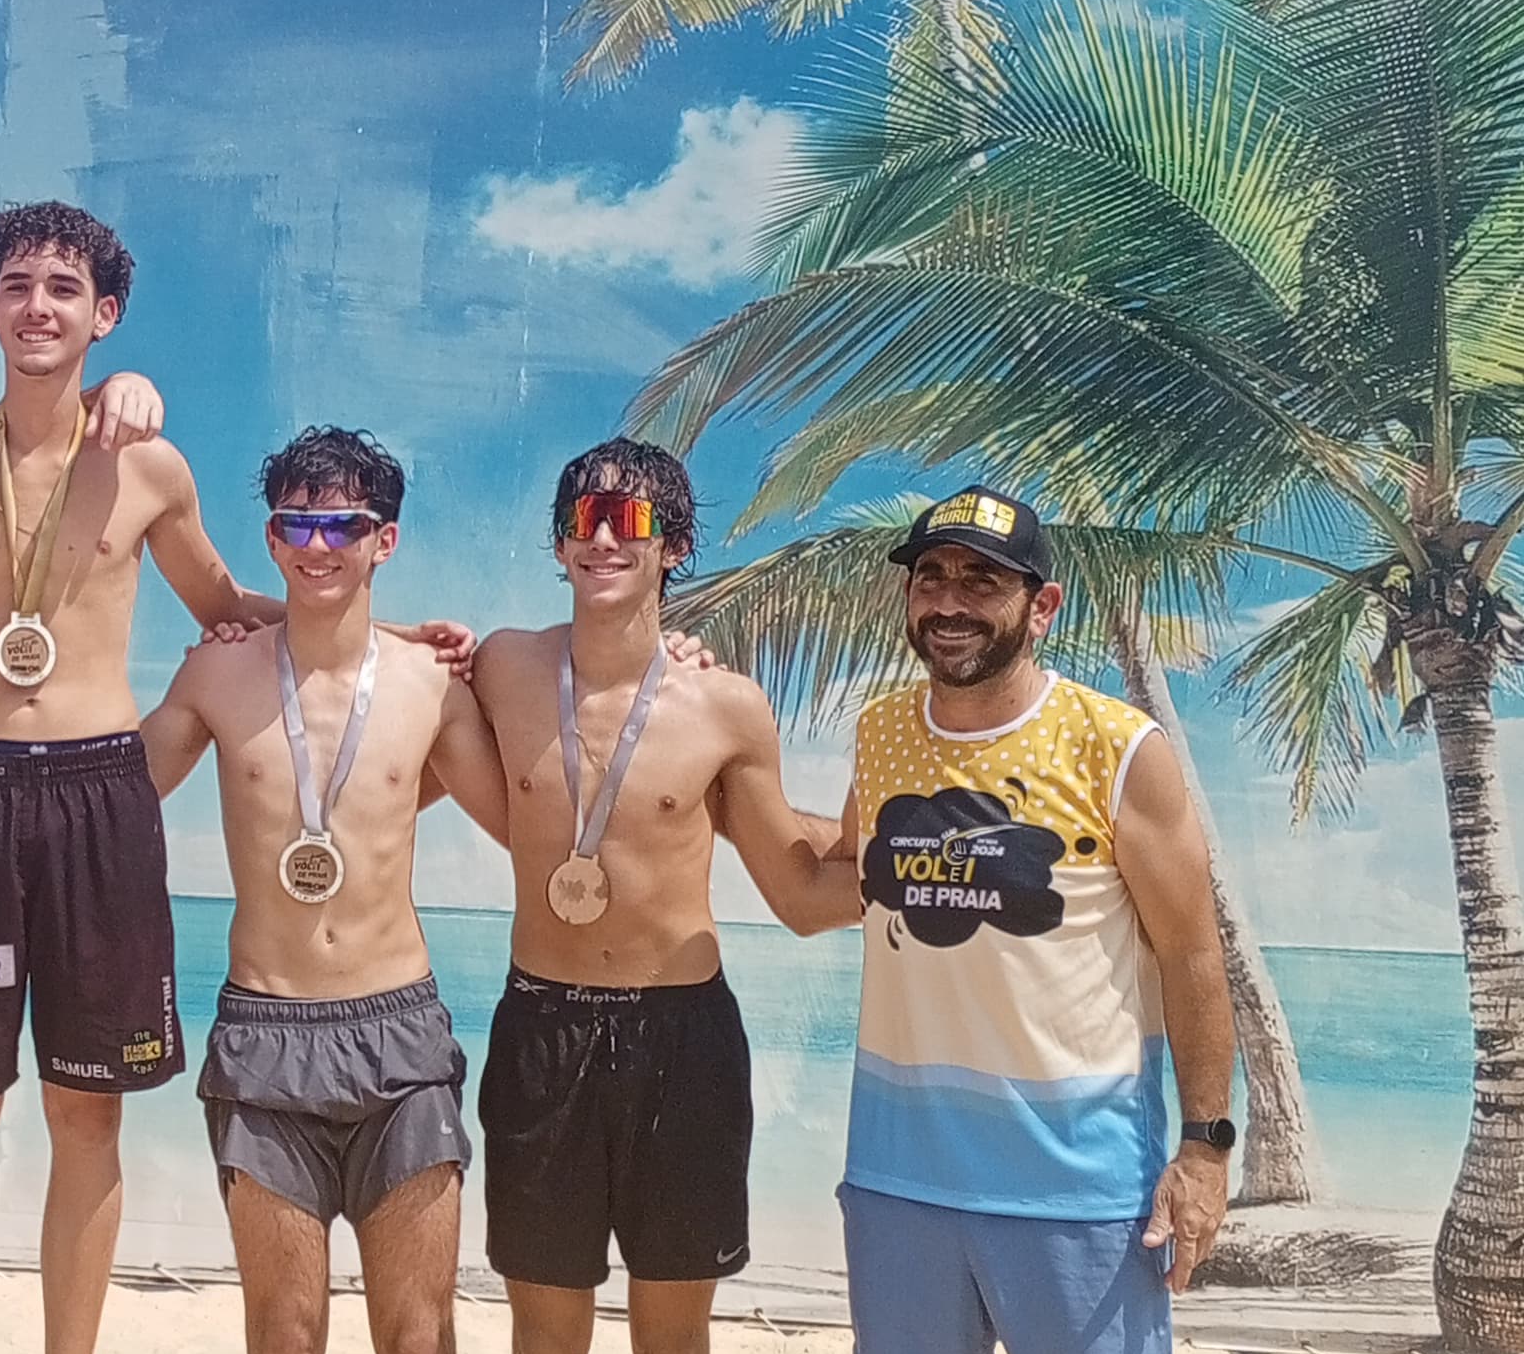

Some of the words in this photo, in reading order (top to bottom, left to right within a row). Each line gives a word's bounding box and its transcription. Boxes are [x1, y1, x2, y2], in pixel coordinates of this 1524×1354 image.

[890, 837, 940, 848] CIRCUITO
[970, 845, 1005, 857] 2024
[894, 848, 975, 883] VÔLEI
[905, 886, 933, 906] DE
[936, 887, 1002, 910] PRAIA
[52, 1057, 115, 1079] SAMUEL
